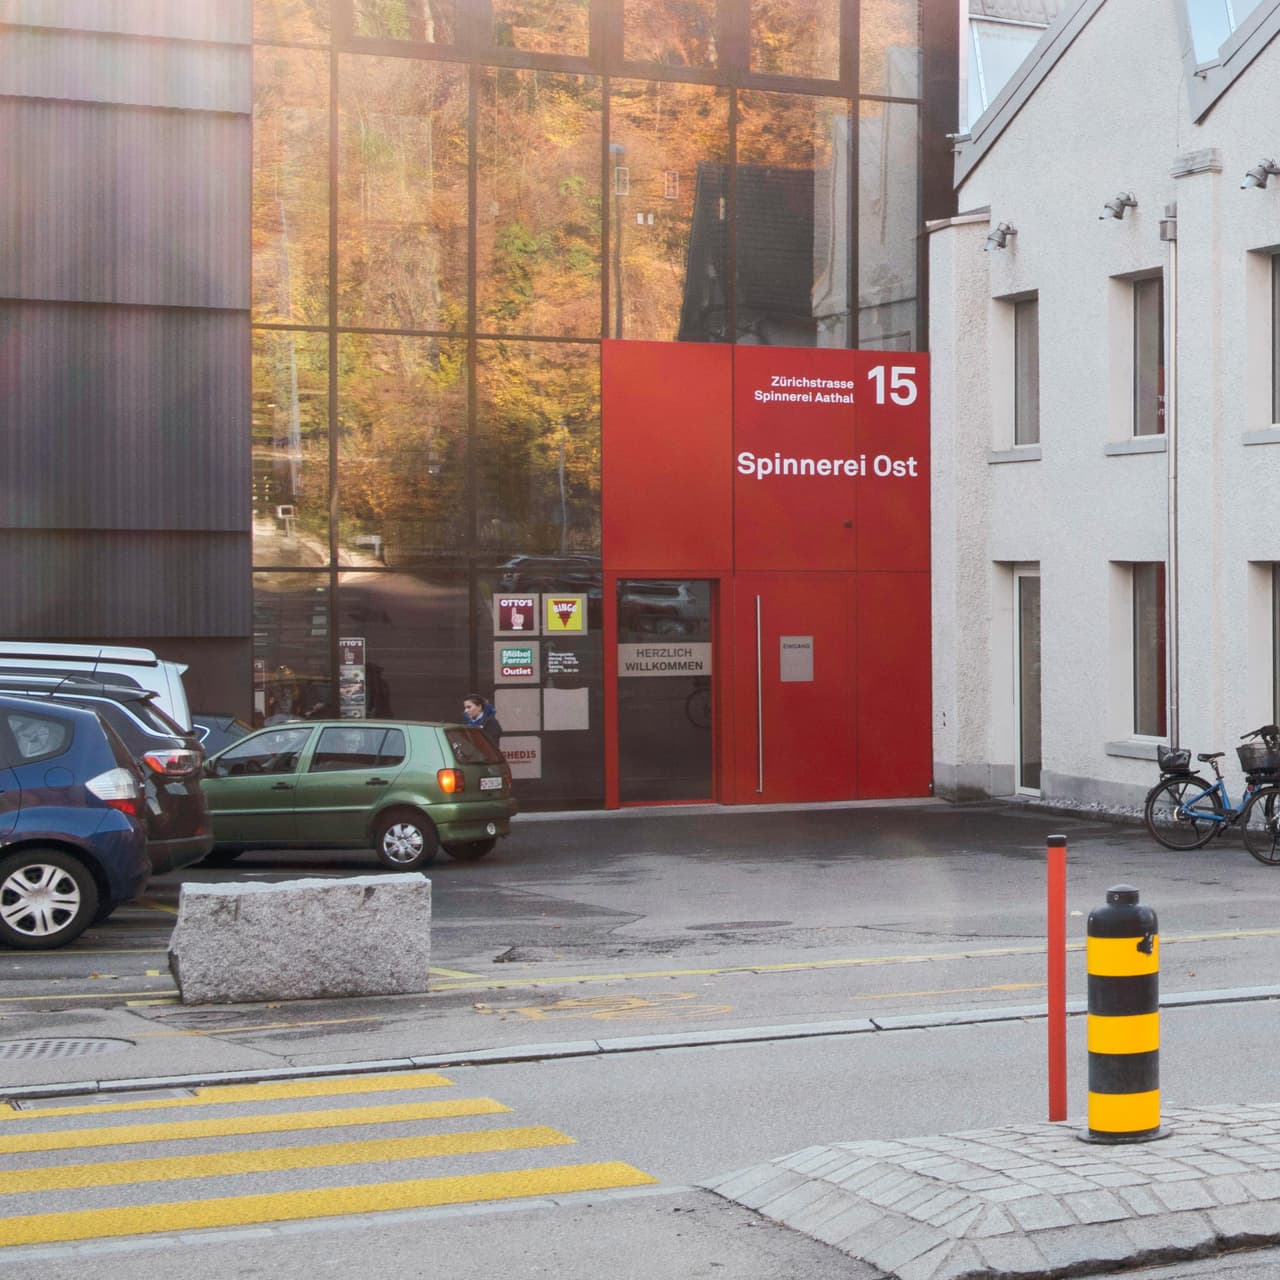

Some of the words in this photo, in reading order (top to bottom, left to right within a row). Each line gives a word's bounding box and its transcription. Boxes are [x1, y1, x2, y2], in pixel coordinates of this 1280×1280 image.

[771, 376, 854, 389] Zürichstrasse
[867, 365, 918, 406] 15
[754, 390, 813, 403] Spinnerei
[814, 393, 854, 404] Aathal
[737, 452, 866, 480] Spinnerei
[873, 455, 918, 477] Ost
[500, 599, 533, 607] OTTO'S
[636, 648, 692, 658] HERZLICH
[503, 667, 532, 676] Outlet
[625, 661, 703, 671] WILLKOMMEN
